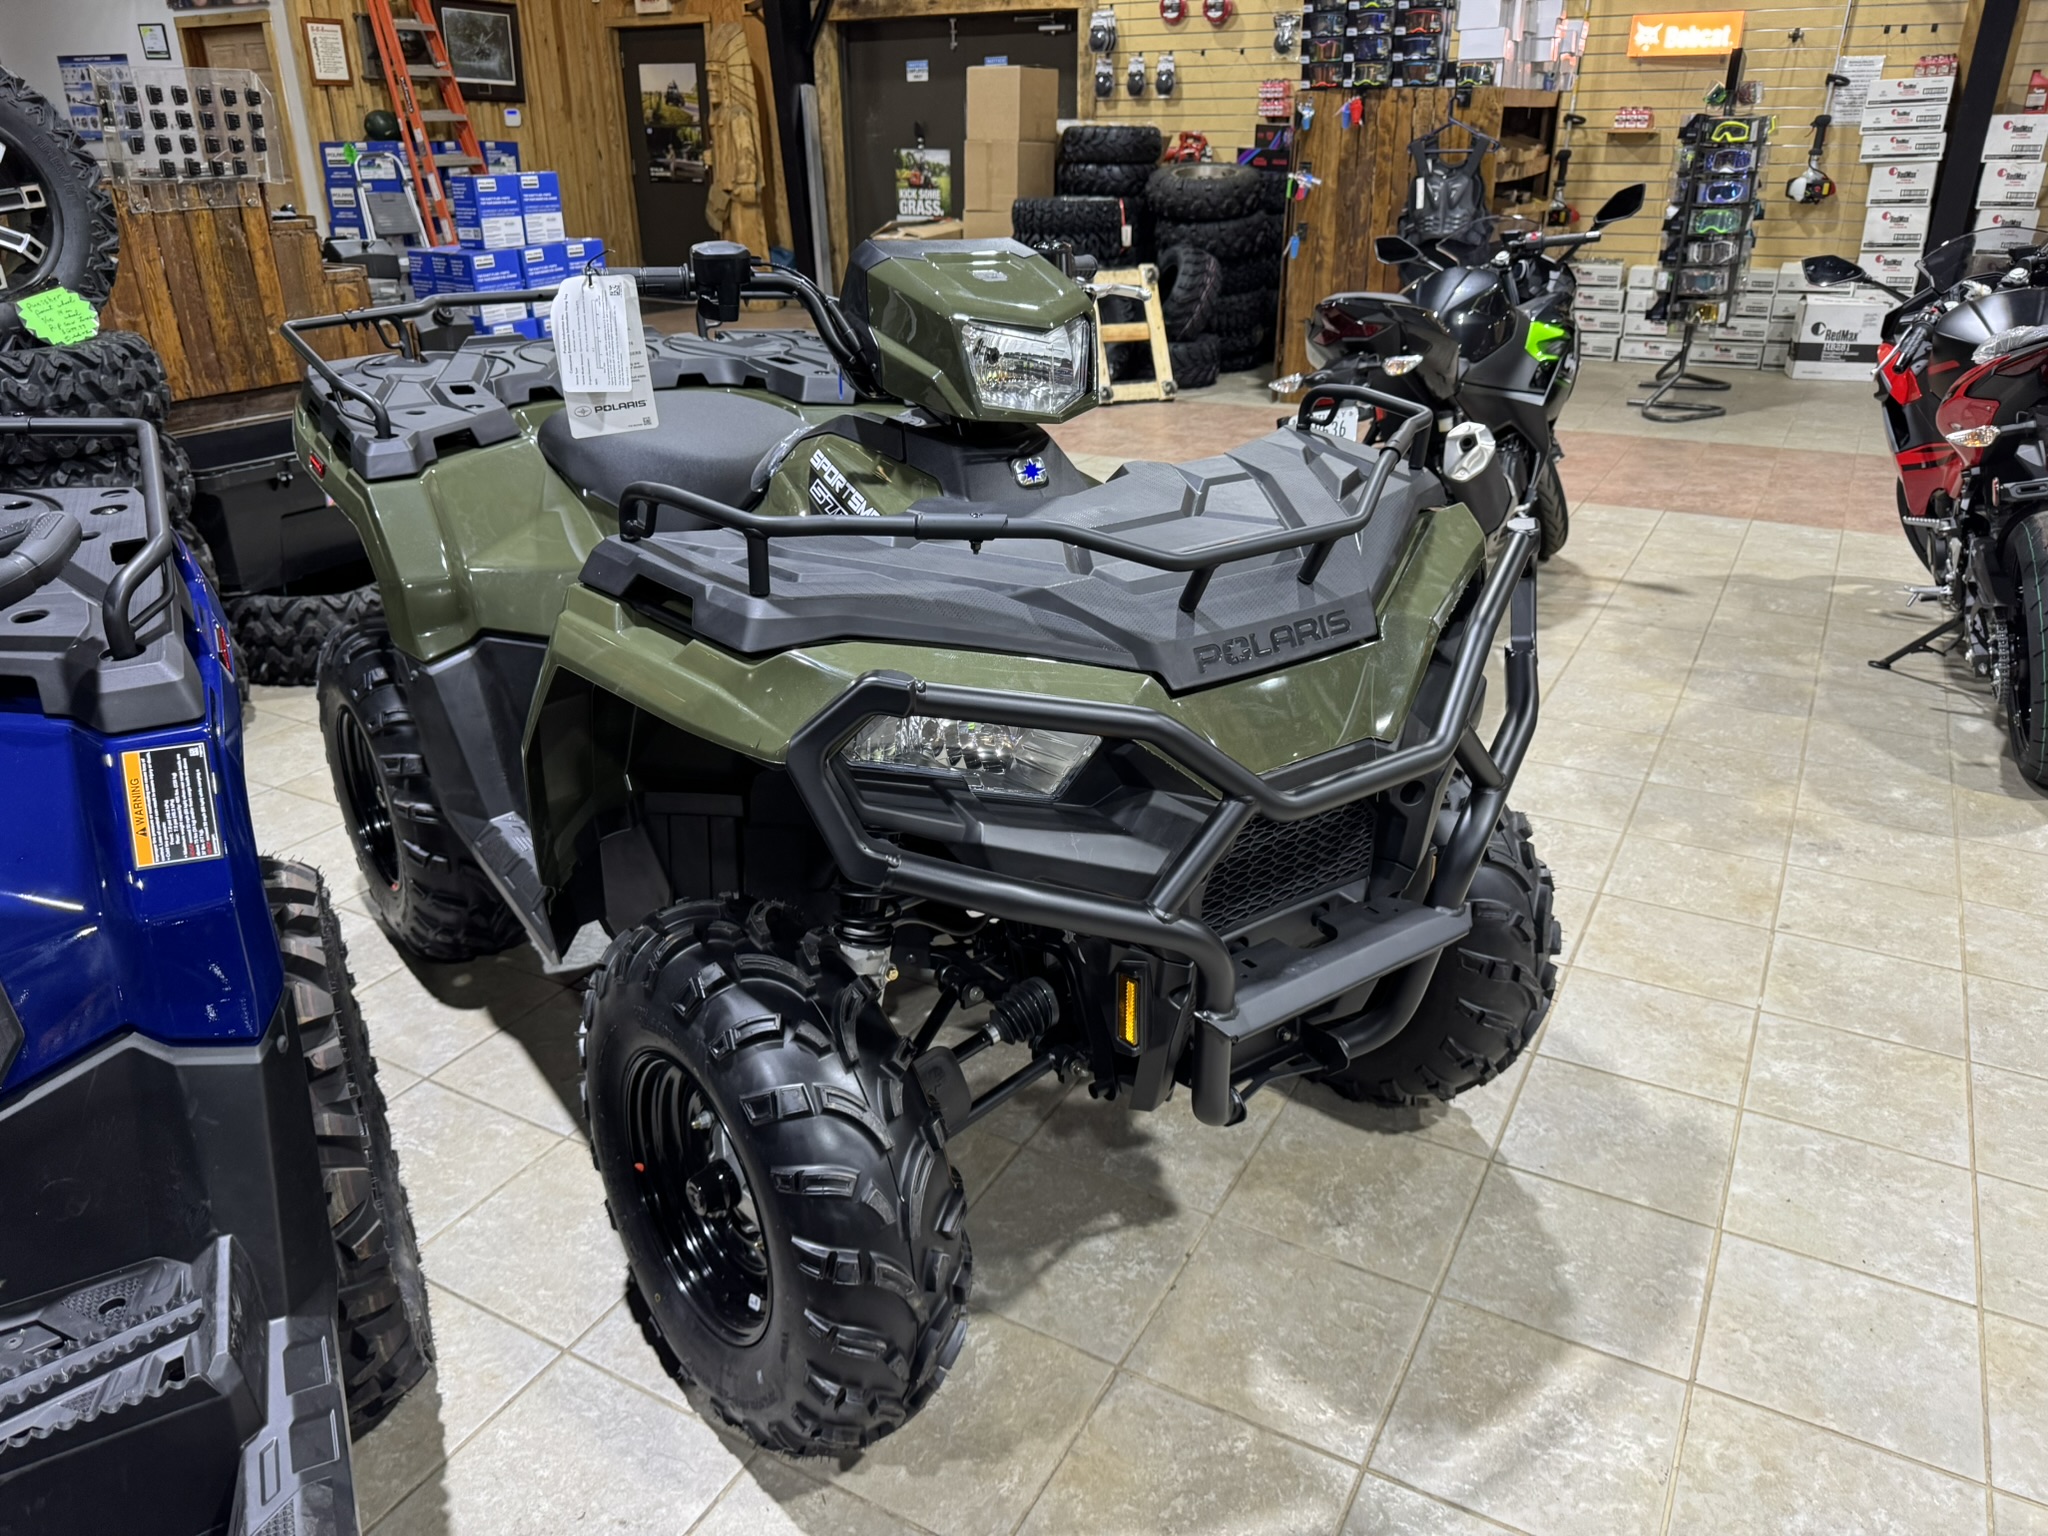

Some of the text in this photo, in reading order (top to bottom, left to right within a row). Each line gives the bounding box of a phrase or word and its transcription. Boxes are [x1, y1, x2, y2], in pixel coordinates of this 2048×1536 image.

[898, 188, 941, 200] KICK SOME
[1825, 329, 1859, 342] RedMax
[595, 400, 647, 413] POLARIS
[810, 449, 881, 516] SPORTSM
[810, 478, 848, 516] 57
[1194, 609, 1351, 674] POLARIS
[130, 778, 145, 826] WARNING
